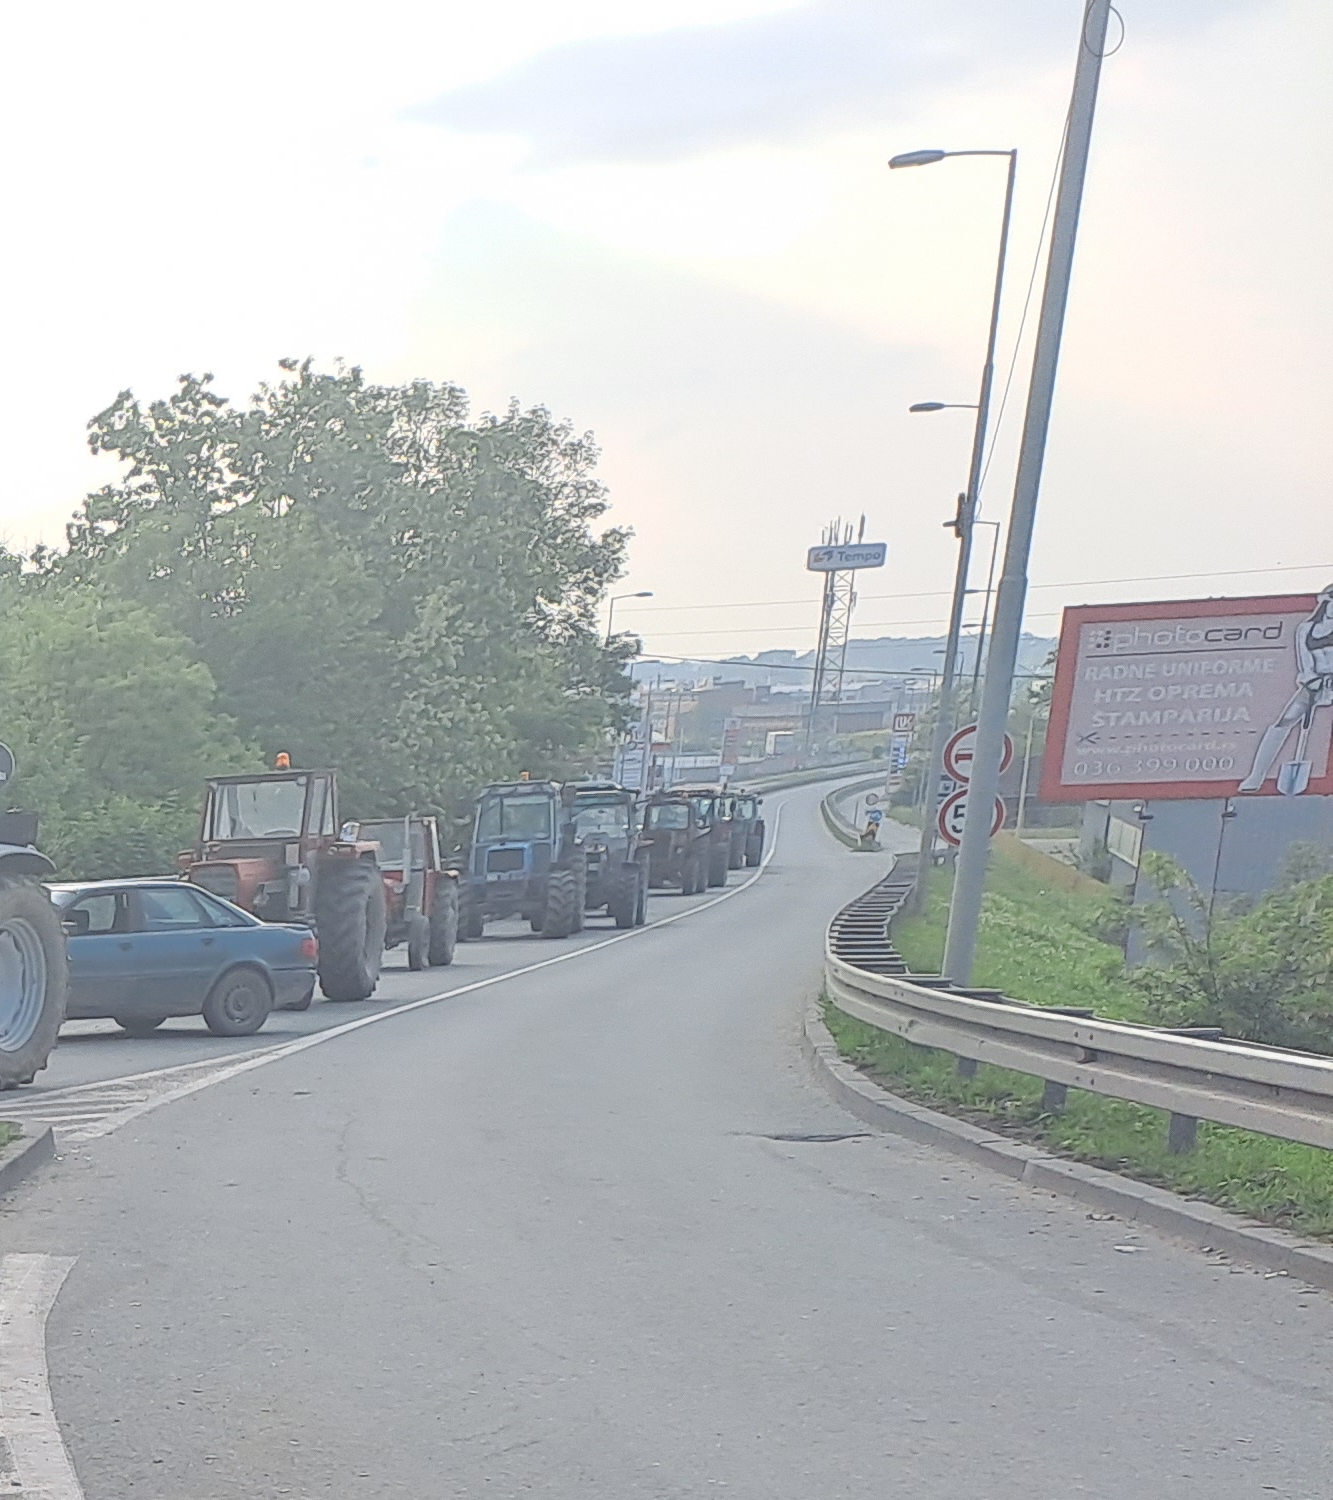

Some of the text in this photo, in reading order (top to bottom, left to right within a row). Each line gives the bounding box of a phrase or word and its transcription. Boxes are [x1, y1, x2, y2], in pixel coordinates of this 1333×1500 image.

[837, 551, 881, 563] Tempo
[1084, 658, 1276, 681] RADNE UNIFORME
[1093, 682, 1253, 704] HTZ OPREMA
[1074, 760, 1121, 776] 036
[1186, 757, 1235, 772] 000
